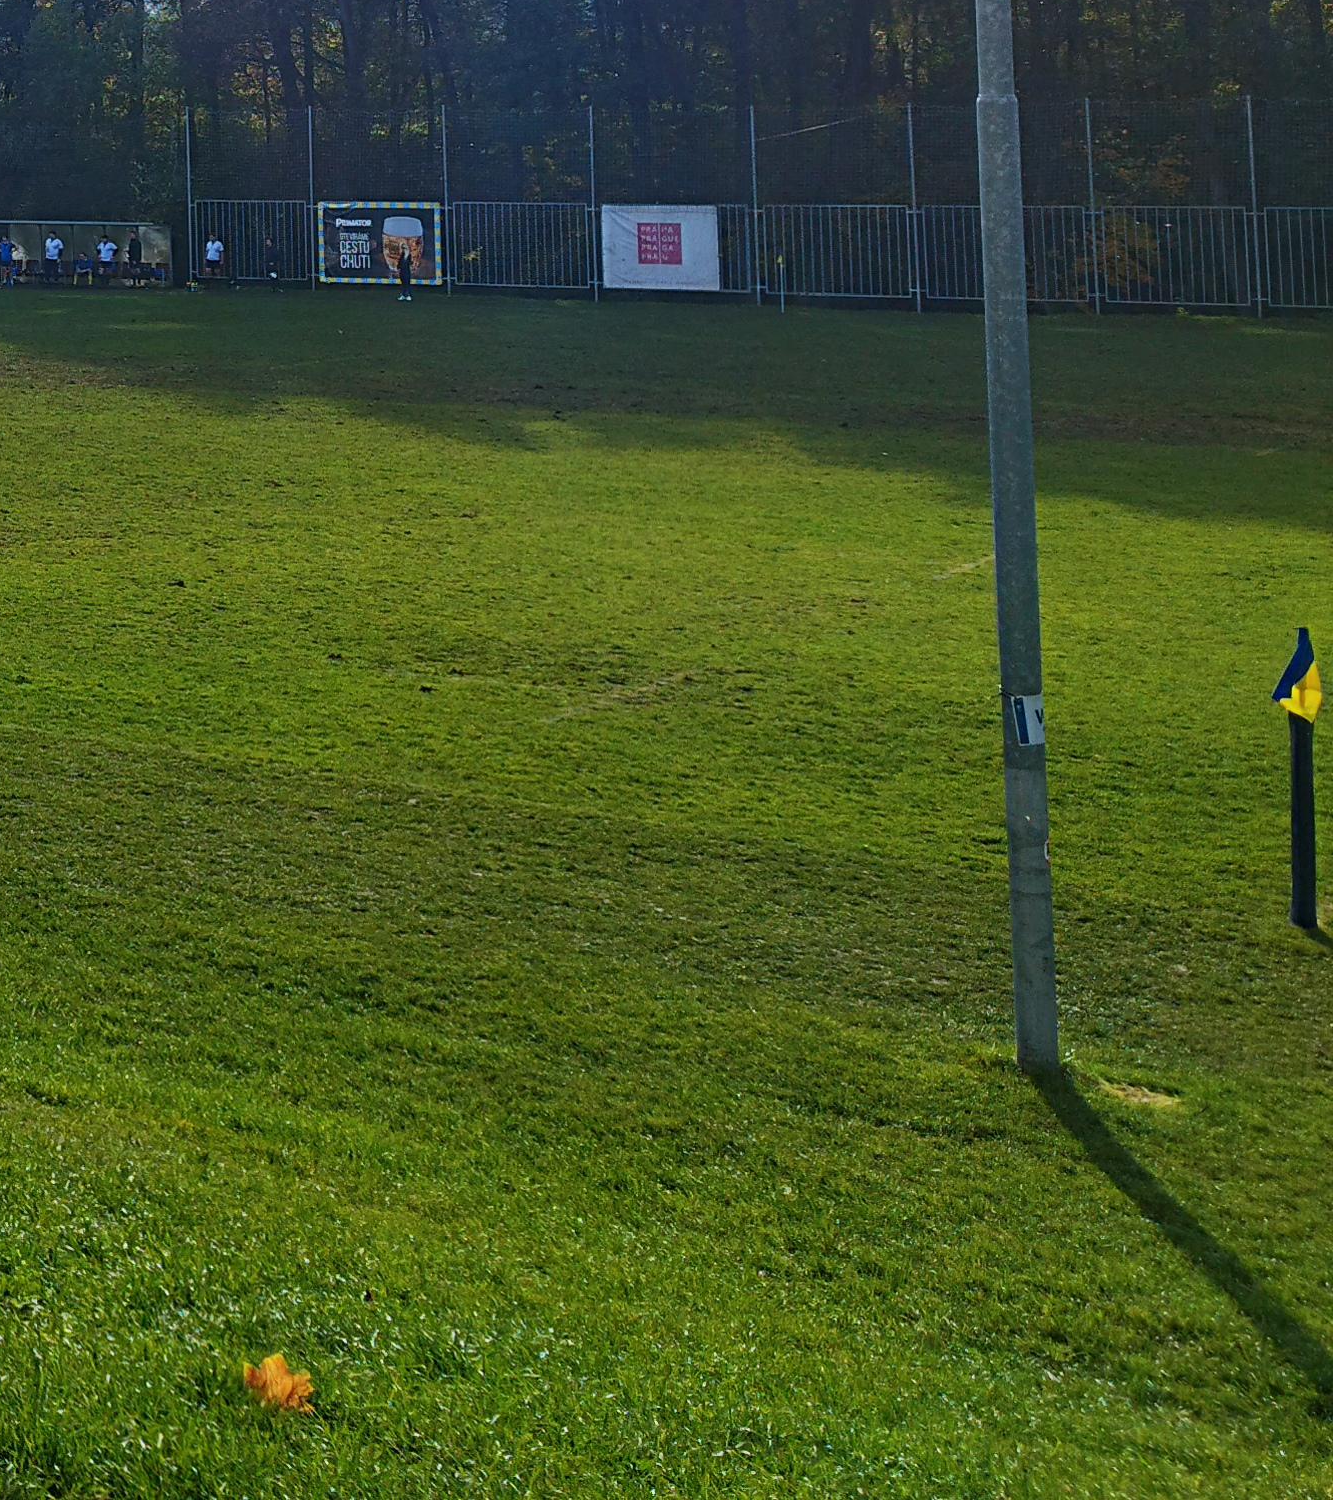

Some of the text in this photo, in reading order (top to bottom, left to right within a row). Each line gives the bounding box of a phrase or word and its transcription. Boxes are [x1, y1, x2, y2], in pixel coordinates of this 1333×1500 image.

[336, 218, 372, 228] PRIMATOR
[340, 240, 370, 254] CESTU
[341, 255, 371, 269] CHUTI
